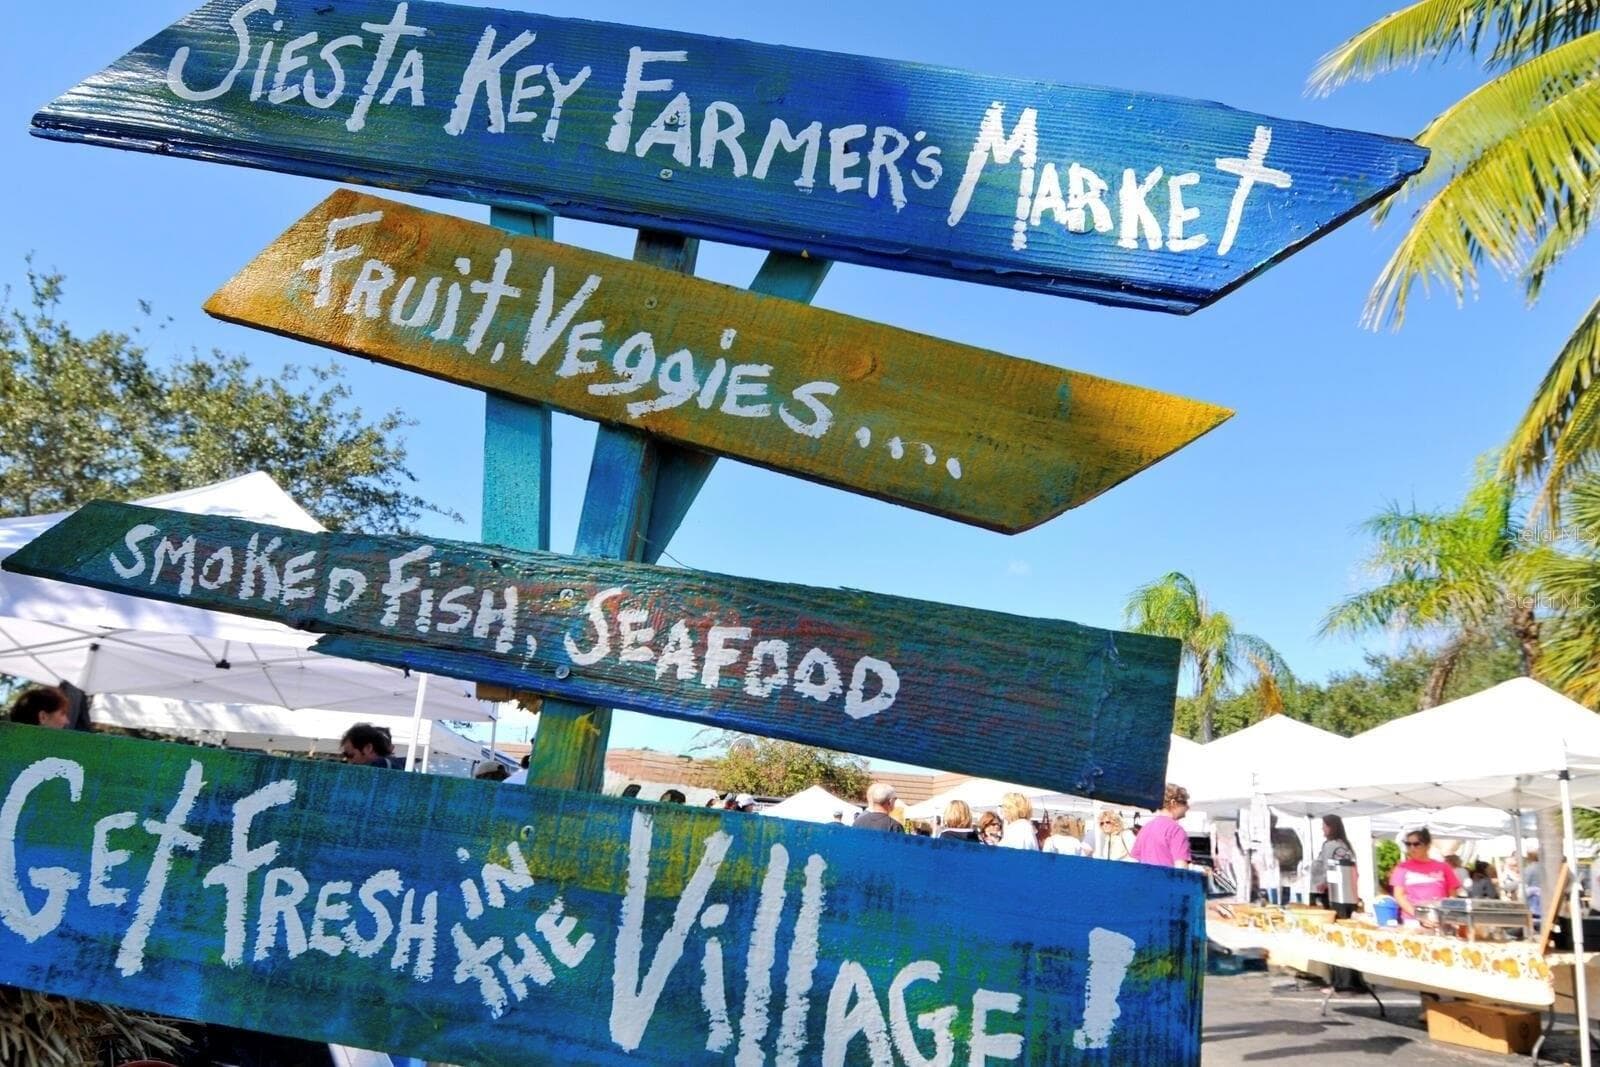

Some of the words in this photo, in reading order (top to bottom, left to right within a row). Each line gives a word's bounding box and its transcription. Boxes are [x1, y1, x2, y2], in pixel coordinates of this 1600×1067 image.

[109, 524, 368, 612] SMOKED
[564, 587, 900, 719] SEAFOOD
[203, 779, 438, 983] FRESH
